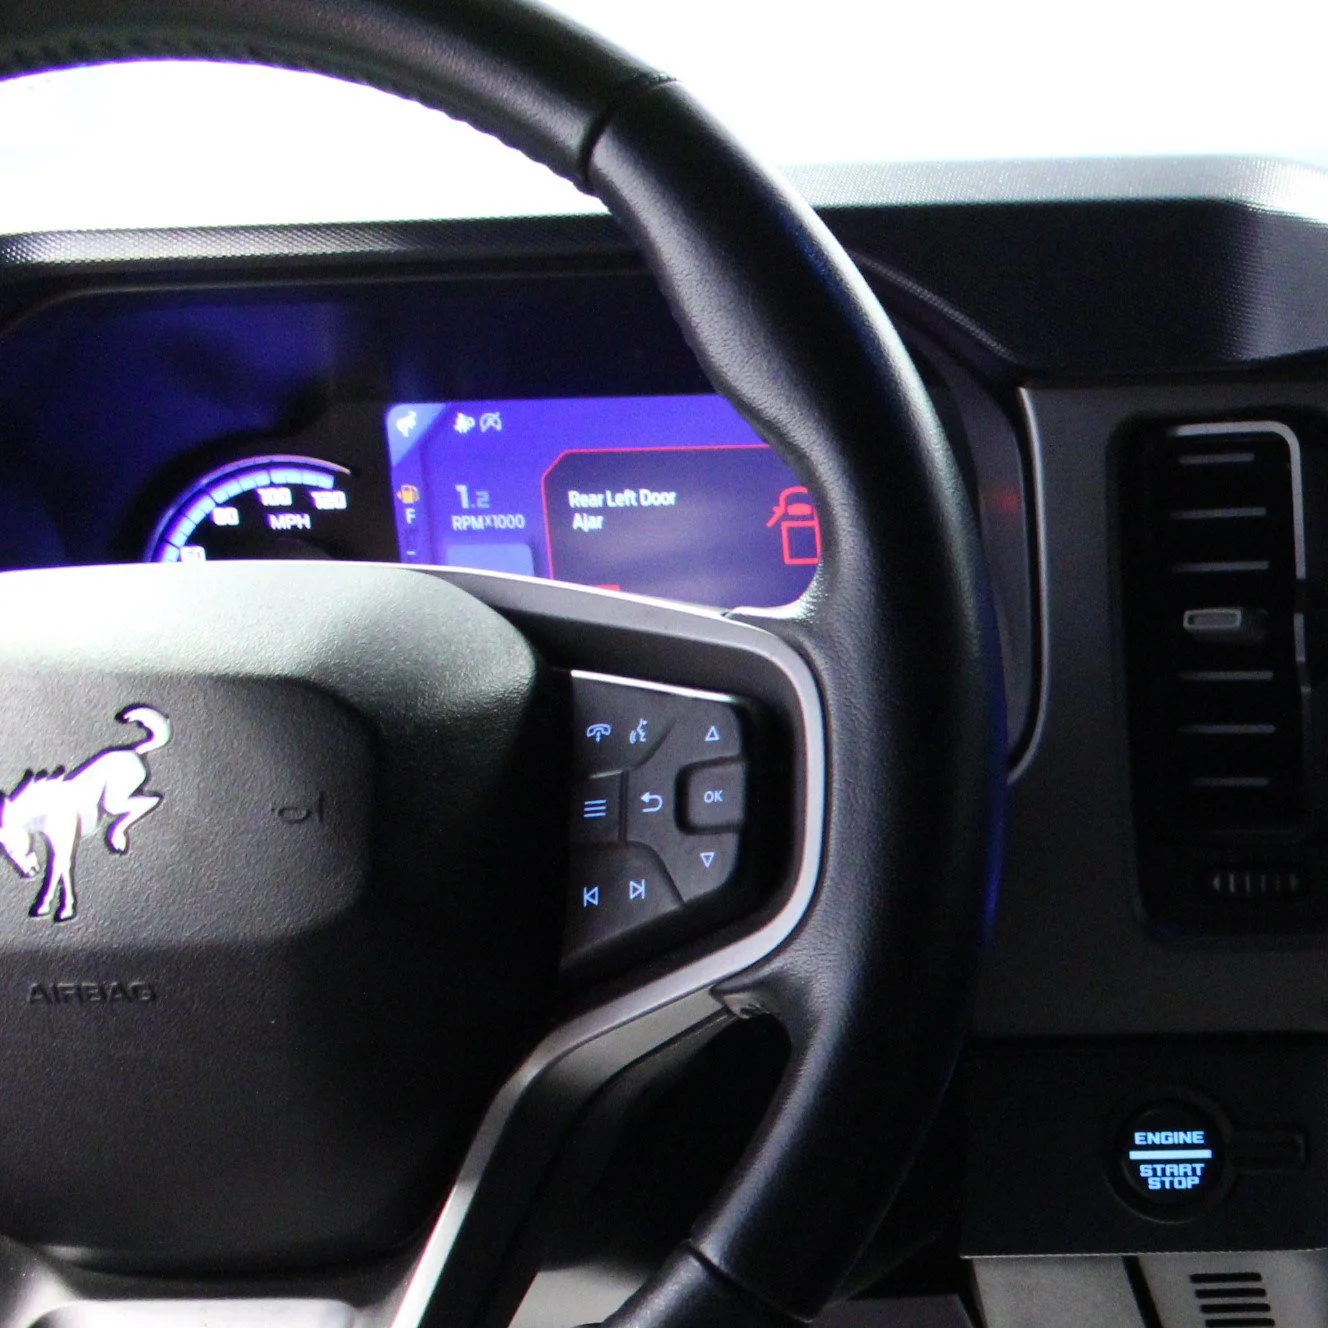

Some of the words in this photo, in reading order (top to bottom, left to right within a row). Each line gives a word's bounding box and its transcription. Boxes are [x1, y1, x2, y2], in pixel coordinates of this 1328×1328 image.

[455, 484, 490, 509] 1.2
[568, 490, 604, 508] Rear
[606, 489, 637, 507] Left
[639, 488, 676, 506] Door
[270, 513, 311, 530] MPH
[404, 508, 416, 524] F
[572, 513, 604, 532] Ajar
[703, 790, 723, 804] OK
[1134, 1131, 1205, 1145] ENGINE
[1139, 1163, 1205, 1177] START
[1148, 1176, 1200, 1190] STOP
